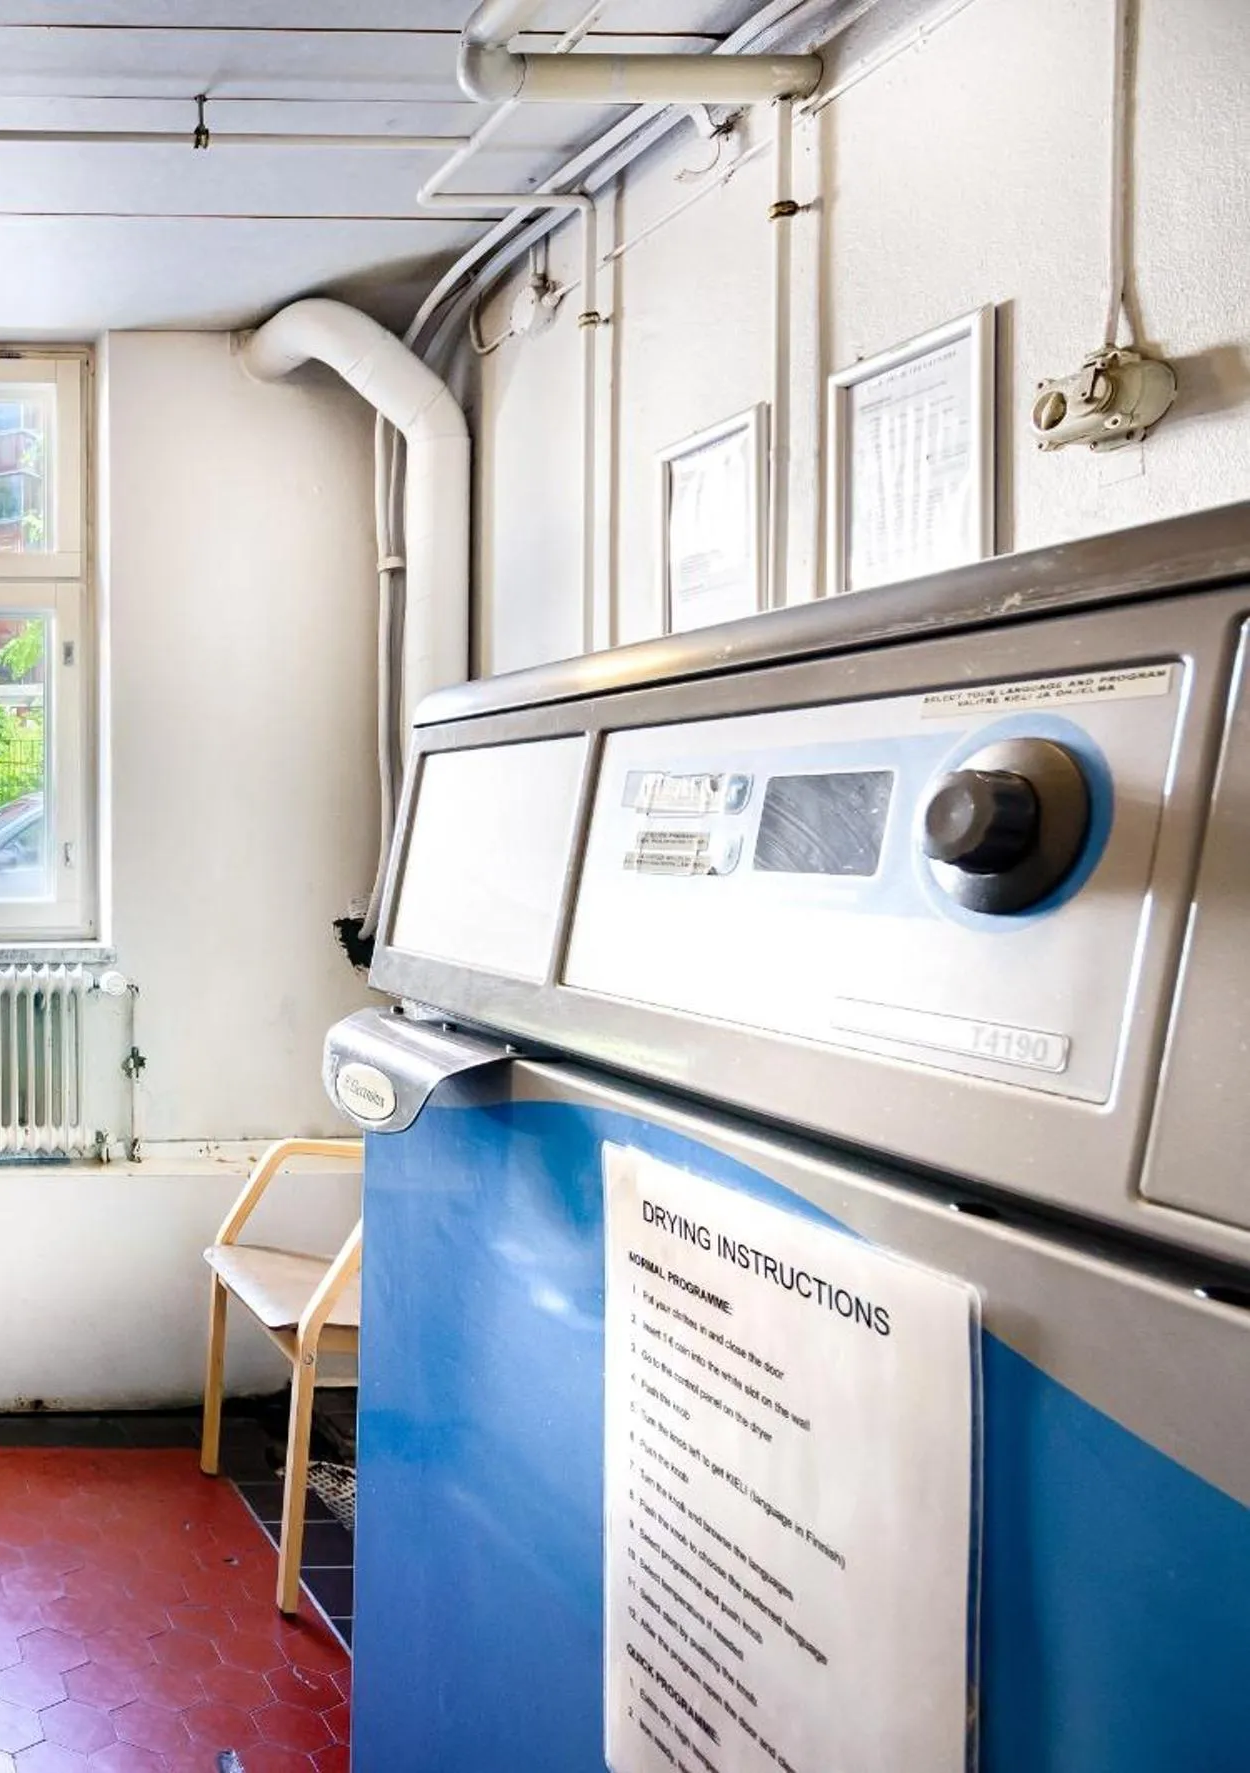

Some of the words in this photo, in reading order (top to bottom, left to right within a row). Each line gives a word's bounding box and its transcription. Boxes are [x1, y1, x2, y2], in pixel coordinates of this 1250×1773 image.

[967, 689, 996, 699] YOUR
[999, 681, 1062, 696] LANGUAGE
[1068, 677, 1094, 687] AND
[1099, 669, 1167, 682] PROGRAM
[971, 1026, 1049, 1062] T4190
[628, 1251, 665, 1280] NORMAL
[643, 1200, 711, 1250] DRYING
[717, 1233, 891, 1336] INSTRUCTIONS
[699, 1323, 707, 1335] in
[708, 1330, 724, 1346] and
[725, 1340, 747, 1359] close
[748, 1351, 762, 1367] the
[763, 1361, 785, 1380] door
[672, 1400, 691, 1421] knob
[691, 1350, 706, 1367] into
[707, 1361, 720, 1376] the
[721, 1370, 742, 1390] white
[744, 1385, 760, 1401] slot
[761, 1395, 773, 1408] on
[774, 1401, 789, 1419] the
[790, 1413, 811, 1432] wall
[700, 1389, 722, 1410] panel
[723, 1404, 734, 1418] on
[735, 1411, 749, 1428] the
[750, 1422, 773, 1443] dryer
[688, 1443, 701, 1461] left
[702, 1453, 710, 1467] to
[711, 1463, 724, 1479] get
[725, 1470, 748, 1496] KIELI
[750, 1489, 792, 1529] (language
[794, 1521, 804, 1538] in
[668, 1491, 686, 1514] knob
[688, 1508, 702, 1527] and
[703, 1519, 732, 1551] browse
[733, 1543, 747, 1563] the
[658, 1513, 669, 1530] the
[669, 1523, 688, 1546] knob
[690, 1540, 697, 1554] to
[698, 1550, 727, 1580] choose
[728, 1573, 742, 1593] the
[743, 1587, 783, 1627] preferred
[704, 1586, 719, 1606] and
[721, 1601, 741, 1626] push
[626, 1642, 654, 1679] QUICK
[679, 1623, 688, 1643] by
[721, 1665, 735, 1687] the
[658, 1633, 669, 1653] the
[723, 1699, 737, 1721] the
[738, 1716, 758, 1740] door
[759, 1736, 777, 1760] and
